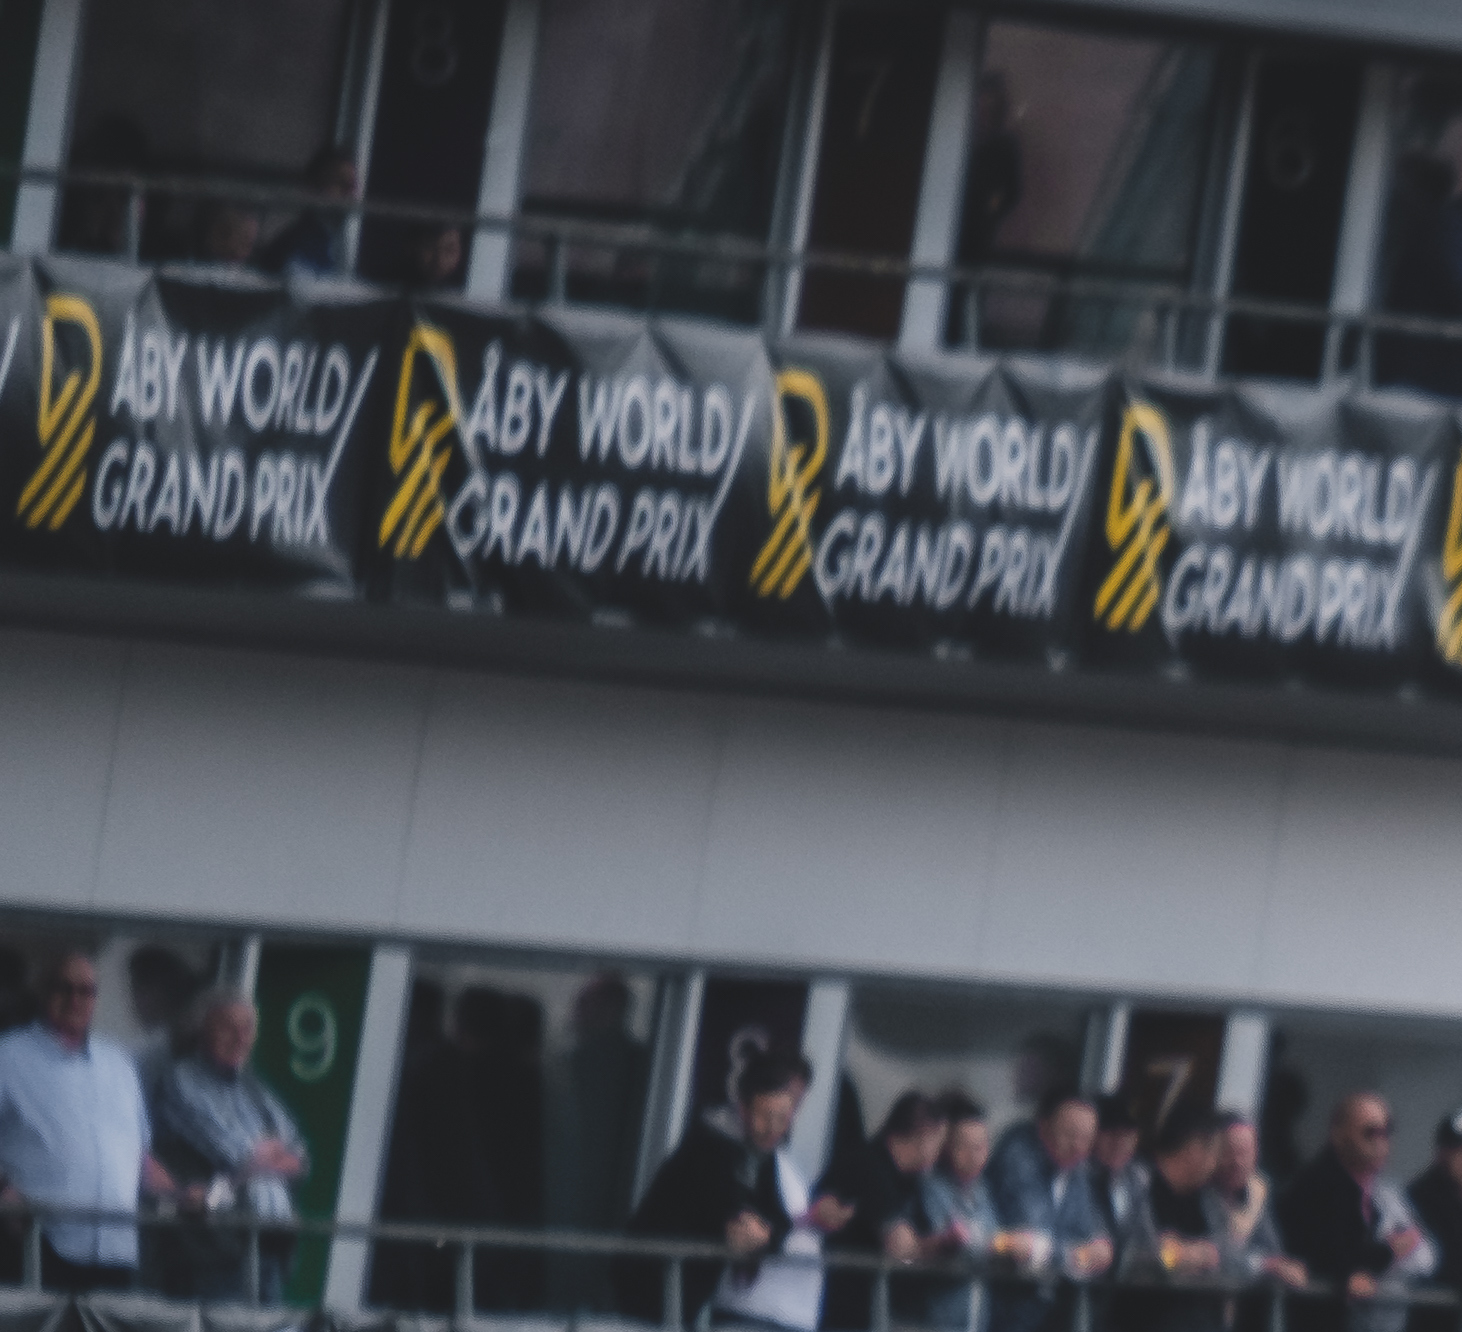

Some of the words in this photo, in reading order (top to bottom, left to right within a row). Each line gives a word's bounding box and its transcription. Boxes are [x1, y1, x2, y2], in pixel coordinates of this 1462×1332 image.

[196, 335, 351, 436] WORLD
[578, 373, 732, 477] WORLD
[91, 437, 246, 541] GRAND
[933, 411, 1078, 514] WORLD
[1277, 449, 1415, 546] WORLD
[446, 470, 621, 574] GRAND
[812, 508, 975, 613] GRAND
[1161, 543, 1318, 644] GRAND
[287, 993, 340, 1082] 9
